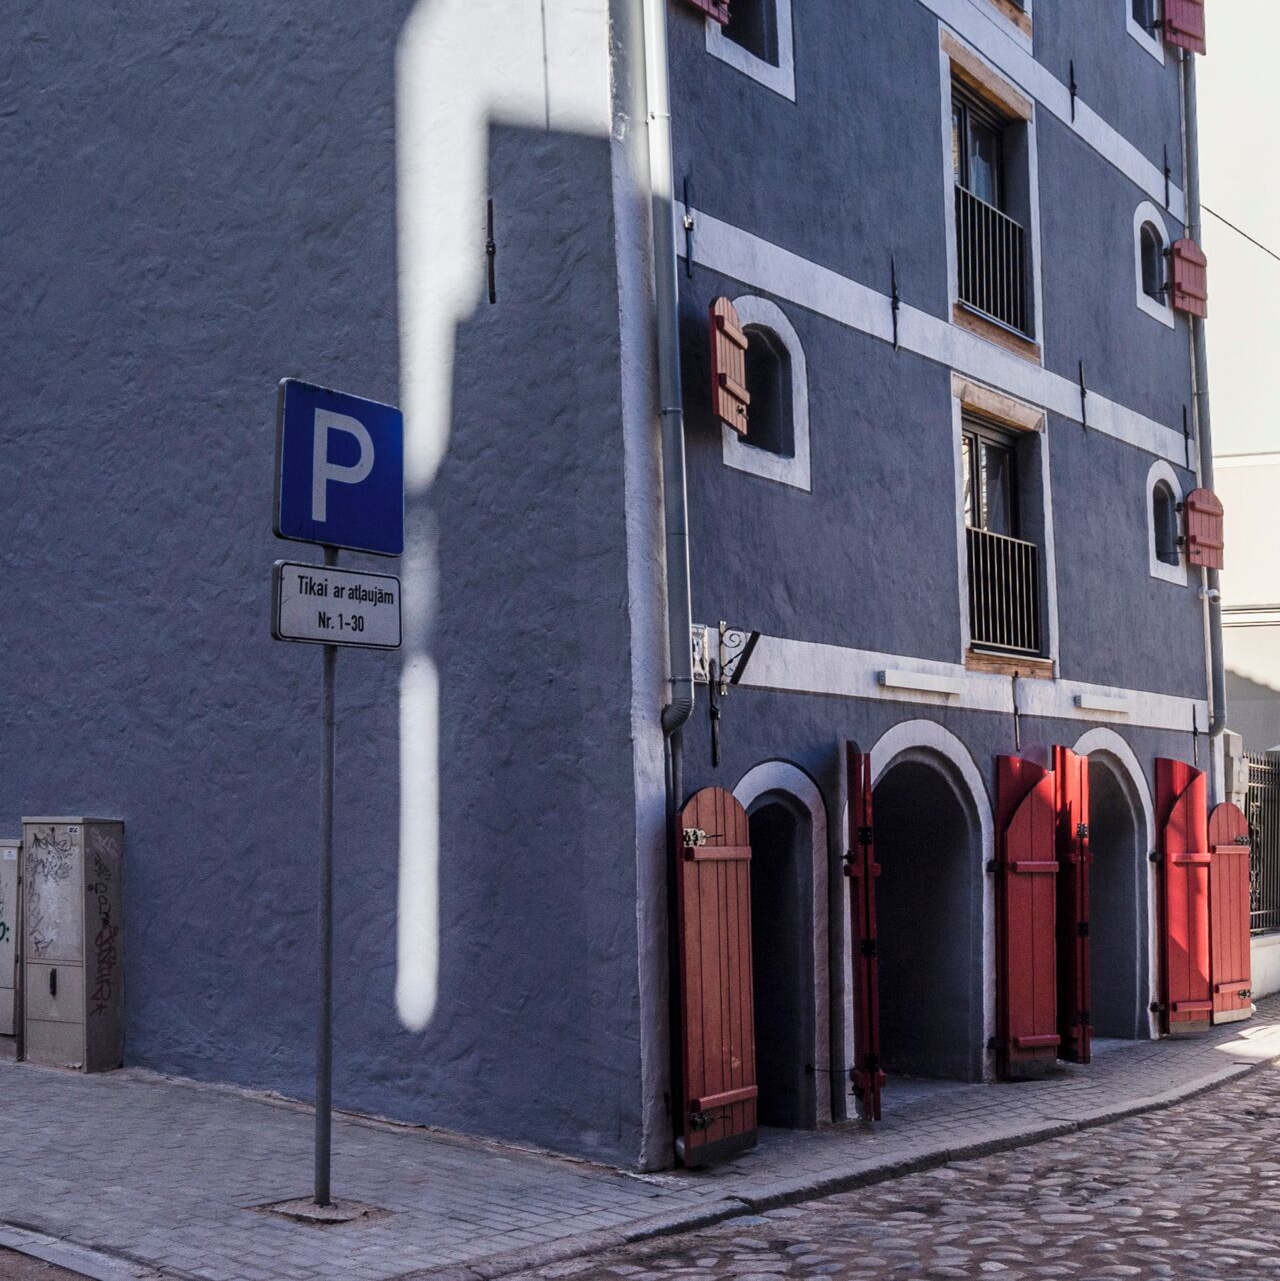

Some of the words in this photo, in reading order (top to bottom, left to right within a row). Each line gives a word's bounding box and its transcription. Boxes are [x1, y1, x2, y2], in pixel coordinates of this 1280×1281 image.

[312, 407, 375, 523] P
[298, 575, 328, 597] Tikai
[333, 585, 345, 599] ar
[348, 584, 394, 607] atļaujām
[318, 611, 335, 630] Nr.
[338, 613, 365, 632] 1-30
